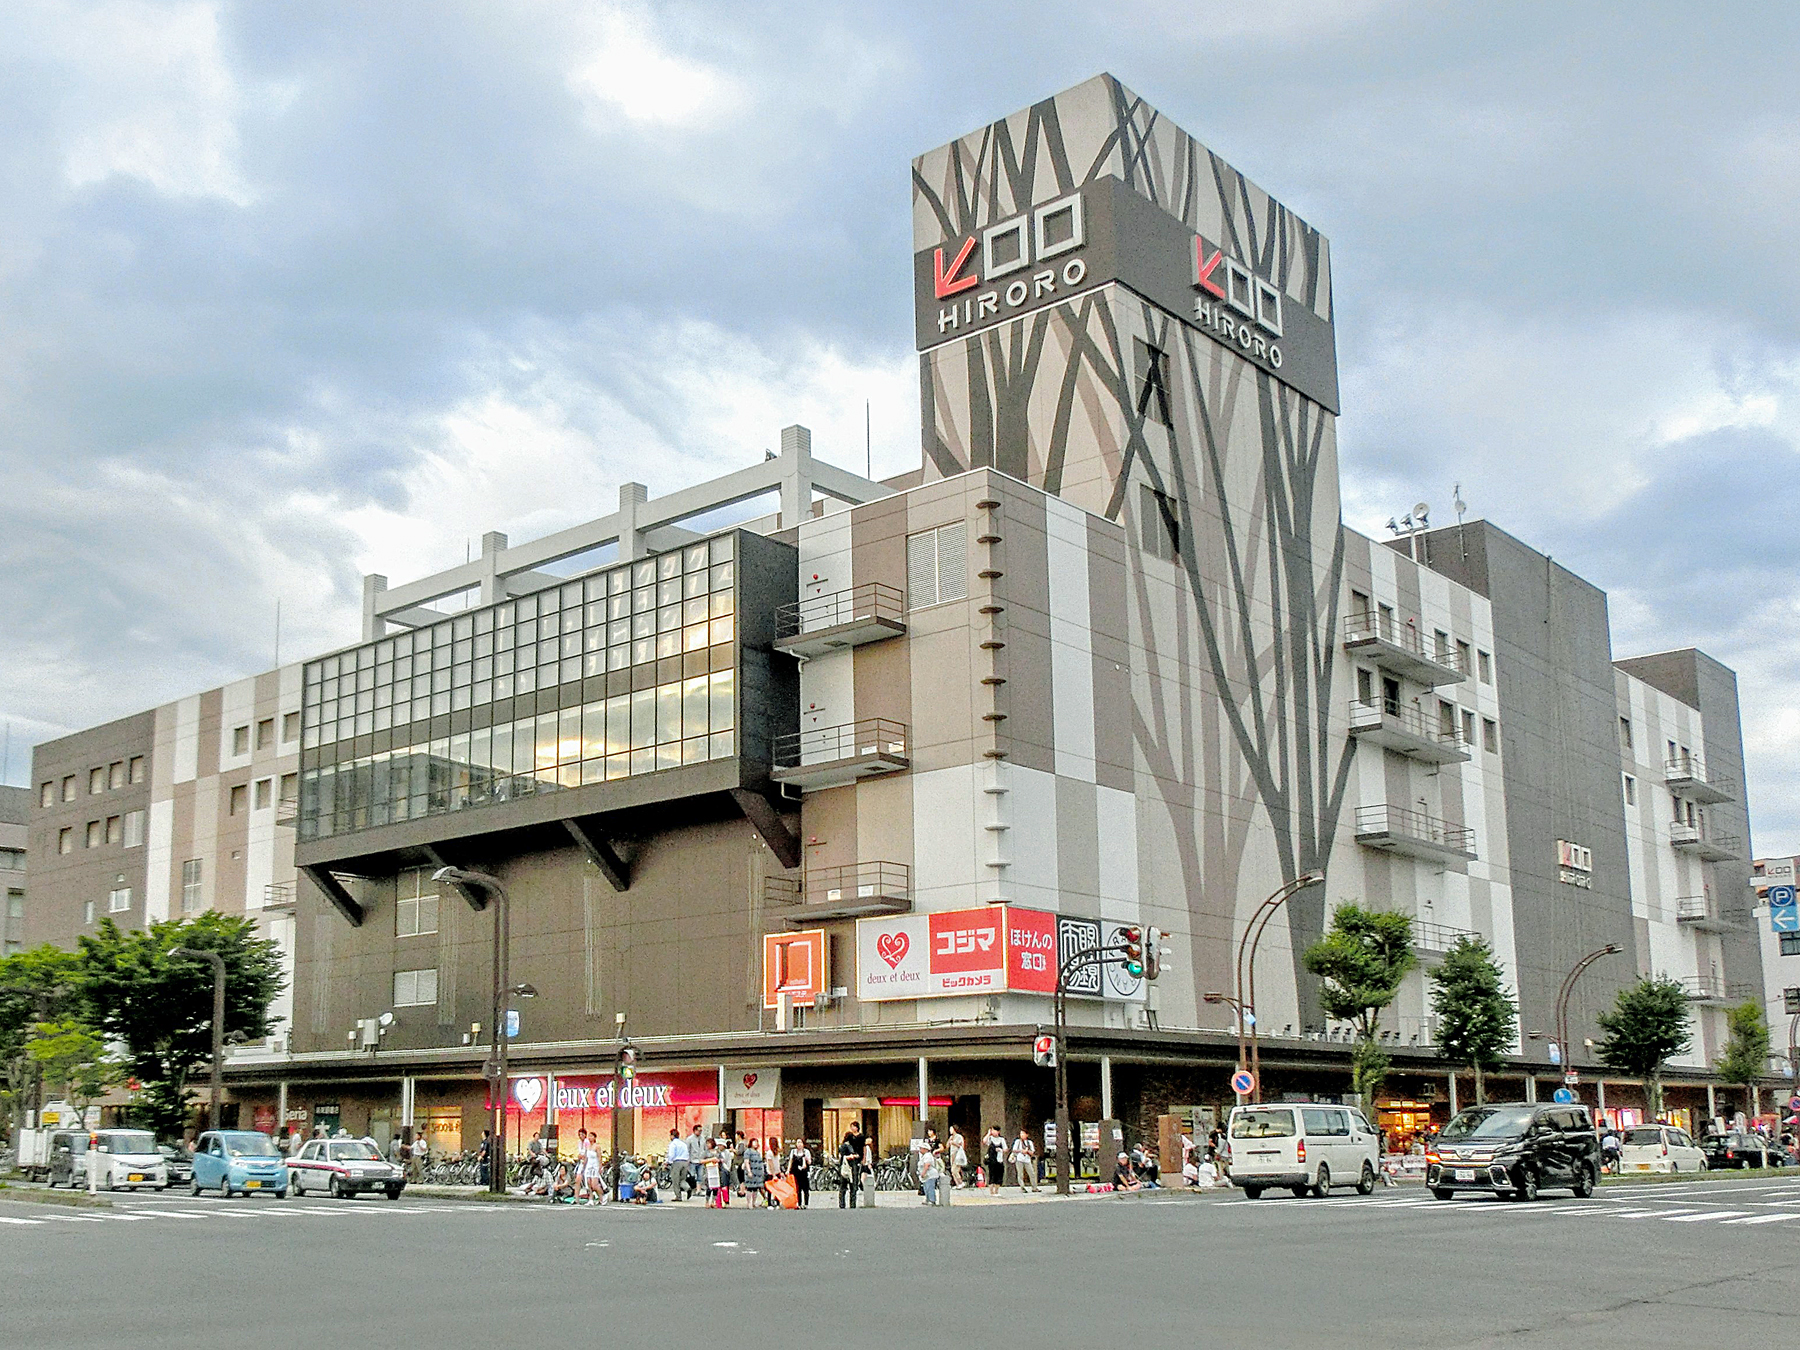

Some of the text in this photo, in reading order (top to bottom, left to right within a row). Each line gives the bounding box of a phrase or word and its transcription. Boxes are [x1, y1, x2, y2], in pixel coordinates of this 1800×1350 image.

[938, 258, 1087, 334] HIRORO
[1194, 297, 1282, 369] HIRORO
[1775, 890, 1789, 903] P
[937, 927, 996, 955] コジマ
[1010, 928, 1053, 950] ほけんの
[1021, 951, 1046, 971] 窓口
[867, 970, 920, 984] deux et deux
[942, 975, 991, 988] ビックカメラ
[620, 1079, 668, 1107] deux
